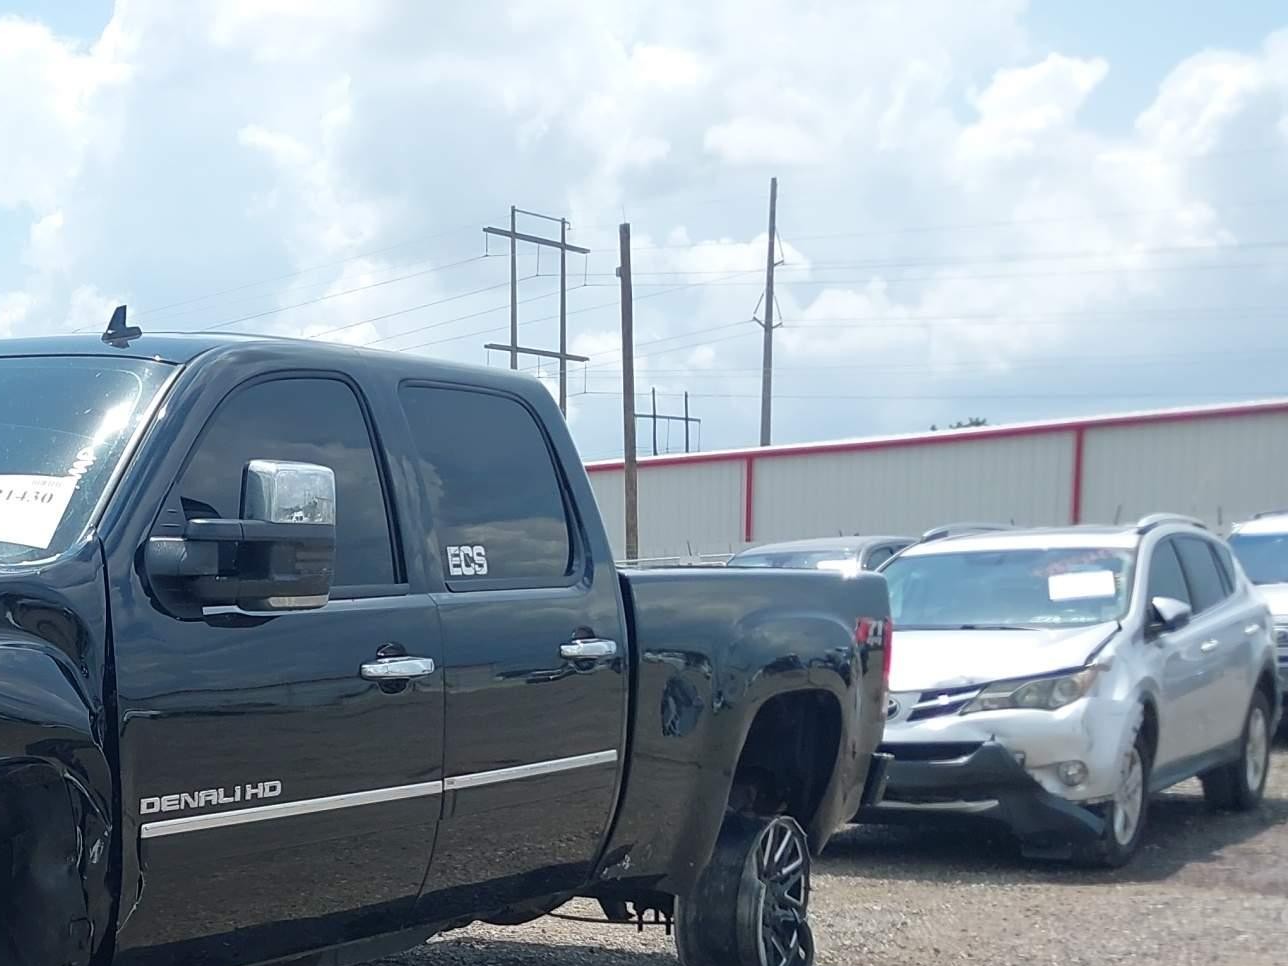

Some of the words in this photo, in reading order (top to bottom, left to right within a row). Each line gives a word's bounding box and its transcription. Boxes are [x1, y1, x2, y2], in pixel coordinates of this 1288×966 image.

[447, 545, 488, 576] ECS
[140, 785, 242, 815] DENALI
[245, 780, 282, 801] HD
